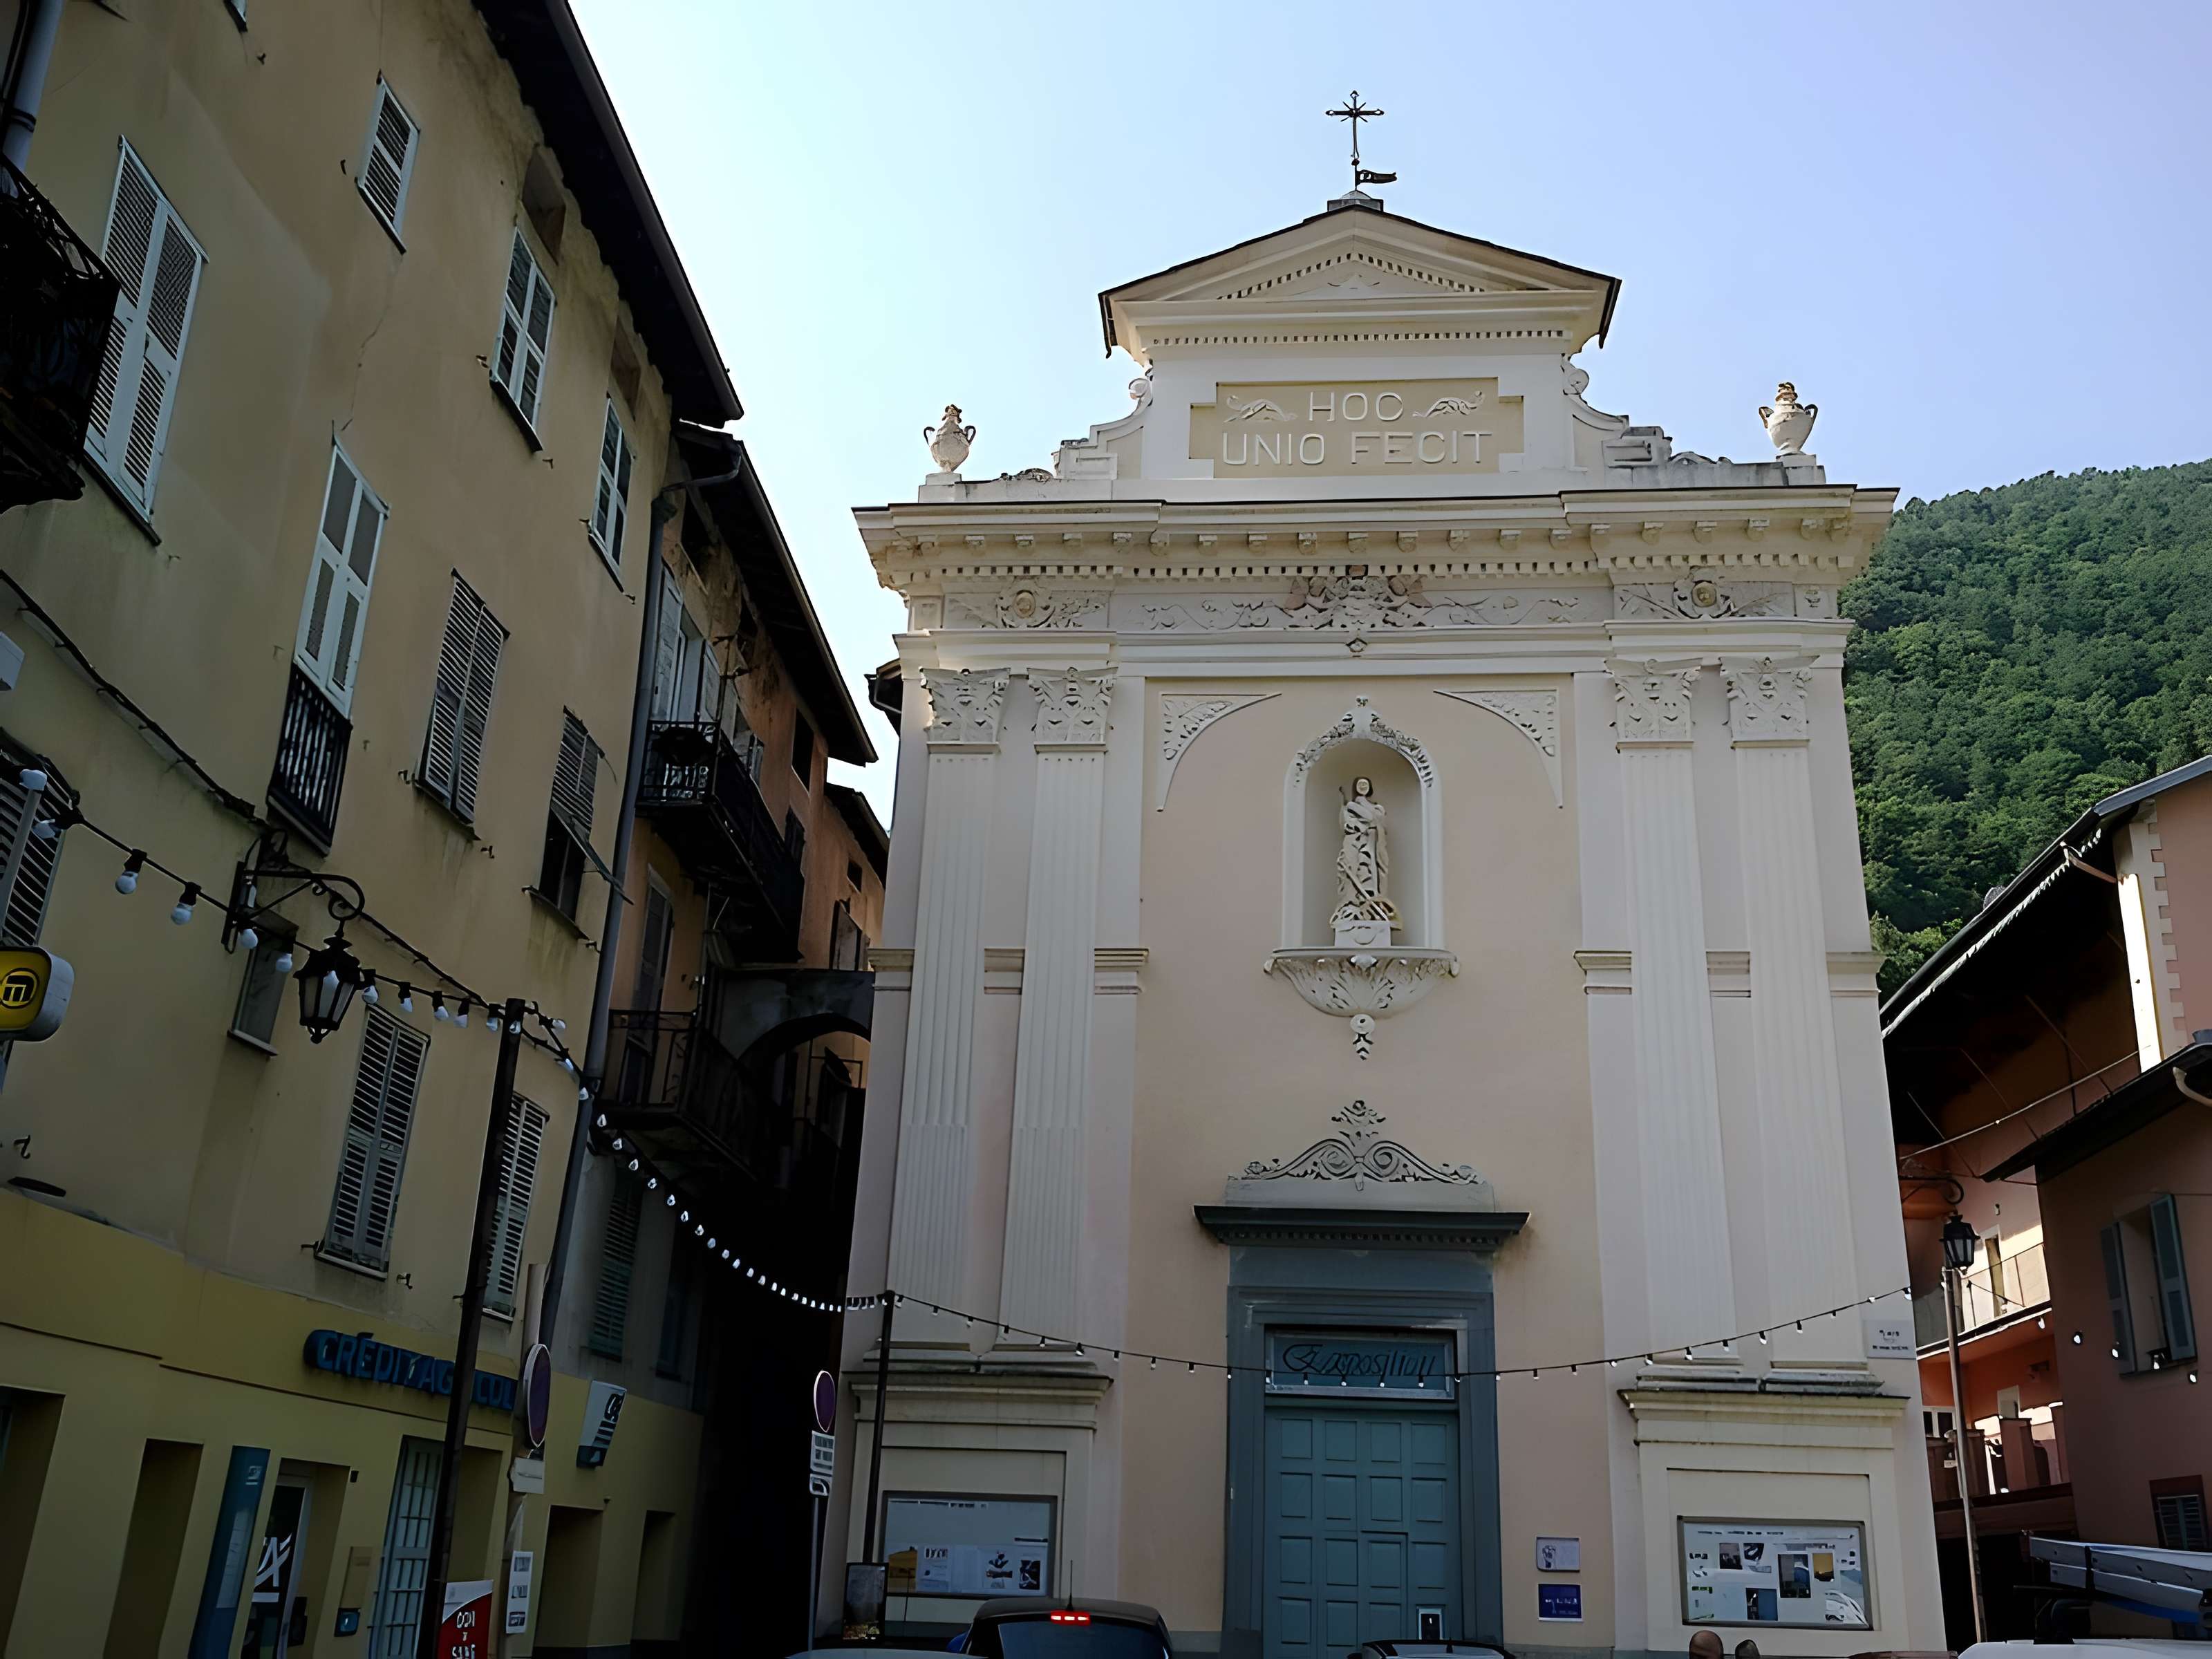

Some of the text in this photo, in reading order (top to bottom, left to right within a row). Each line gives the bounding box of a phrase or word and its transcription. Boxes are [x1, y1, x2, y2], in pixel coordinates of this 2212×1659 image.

[1309, 391, 1405, 422] HOC
[1222, 430, 1492, 466] UNIO FECIT
